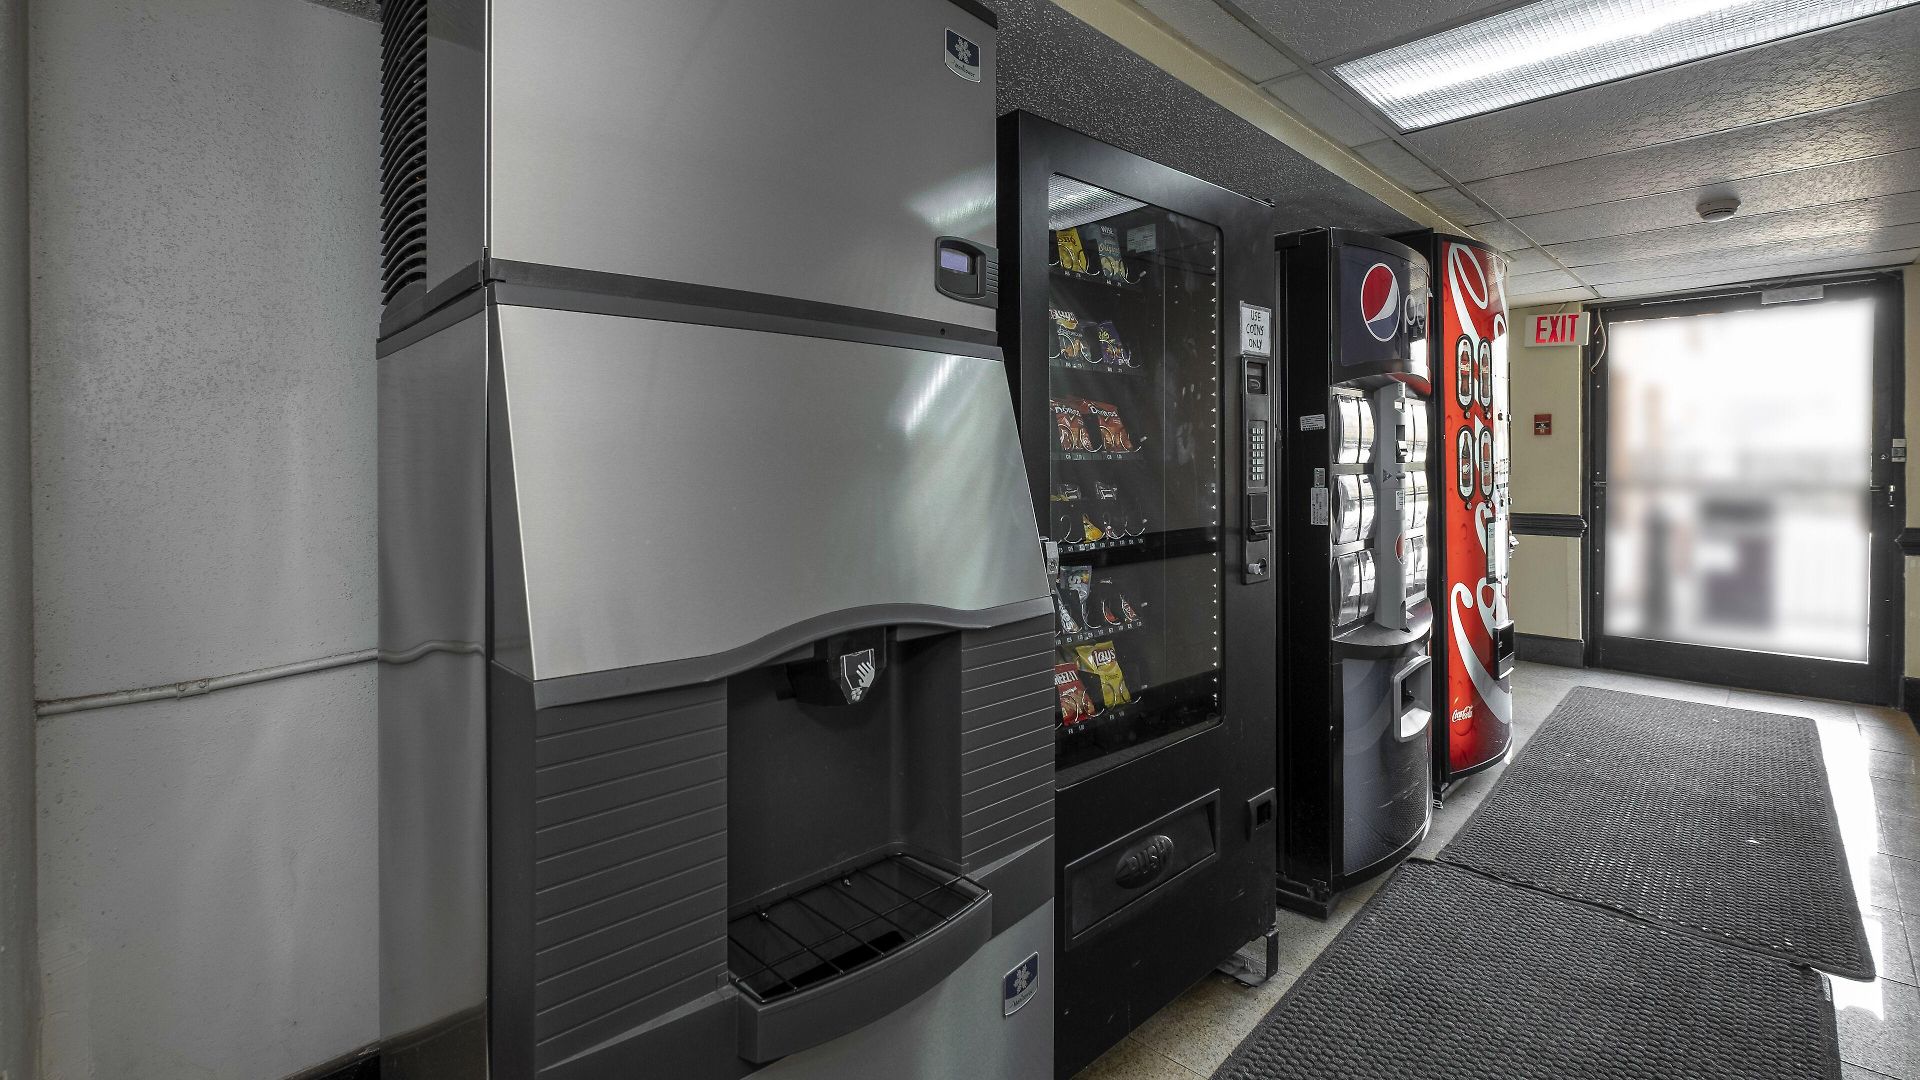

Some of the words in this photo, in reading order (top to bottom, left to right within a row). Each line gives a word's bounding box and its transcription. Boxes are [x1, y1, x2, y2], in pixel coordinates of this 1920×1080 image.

[1250, 310, 1261, 321] USE
[1246, 323, 1264, 336] COINS
[1535, 314, 1579, 343] EXIT
[1248, 338, 1262, 350] ONLY
